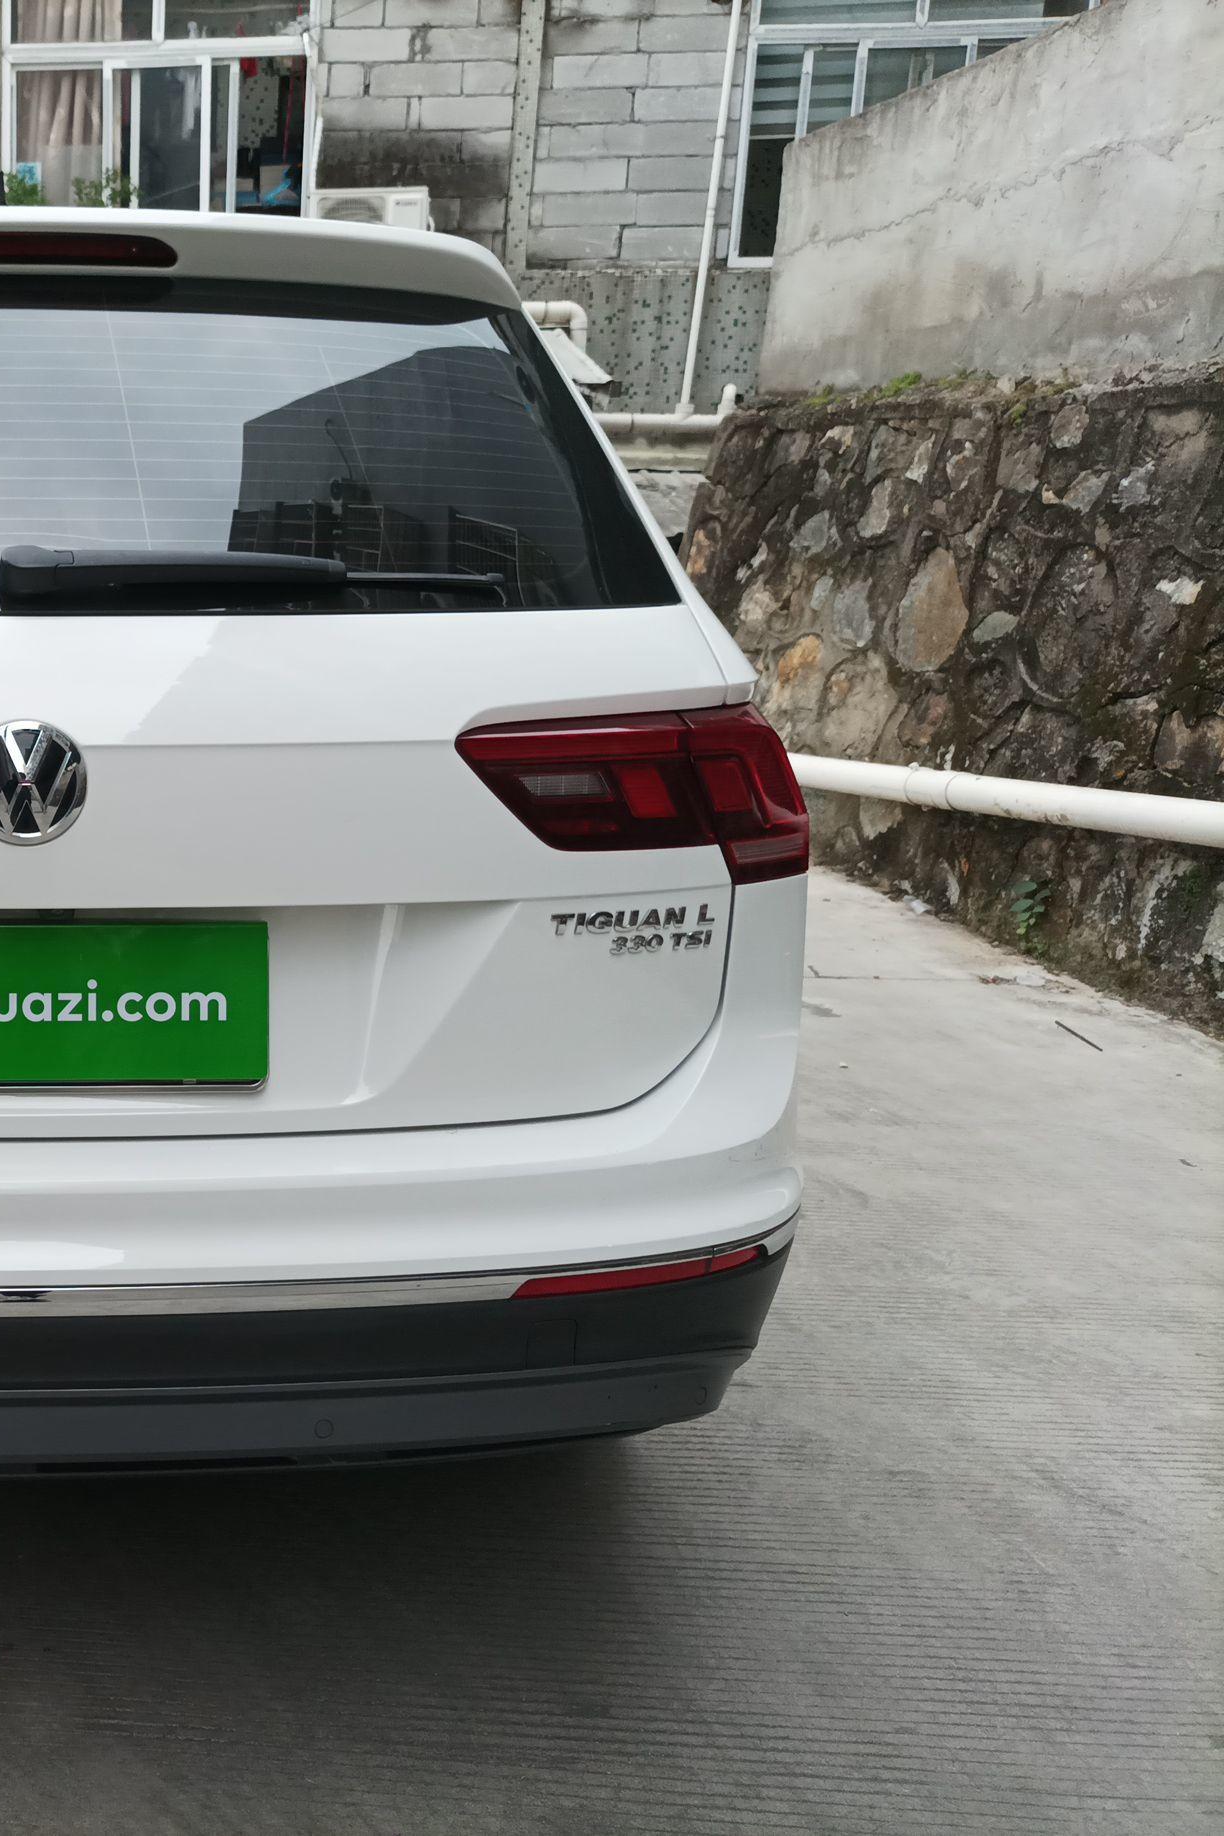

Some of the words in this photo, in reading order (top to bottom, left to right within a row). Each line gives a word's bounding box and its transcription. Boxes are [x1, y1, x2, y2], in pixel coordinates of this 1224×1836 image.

[550, 905, 687, 936] TIGUAN
[696, 903, 715, 926] L
[609, 934, 664, 955] 330
[670, 929, 713, 951] TSI
